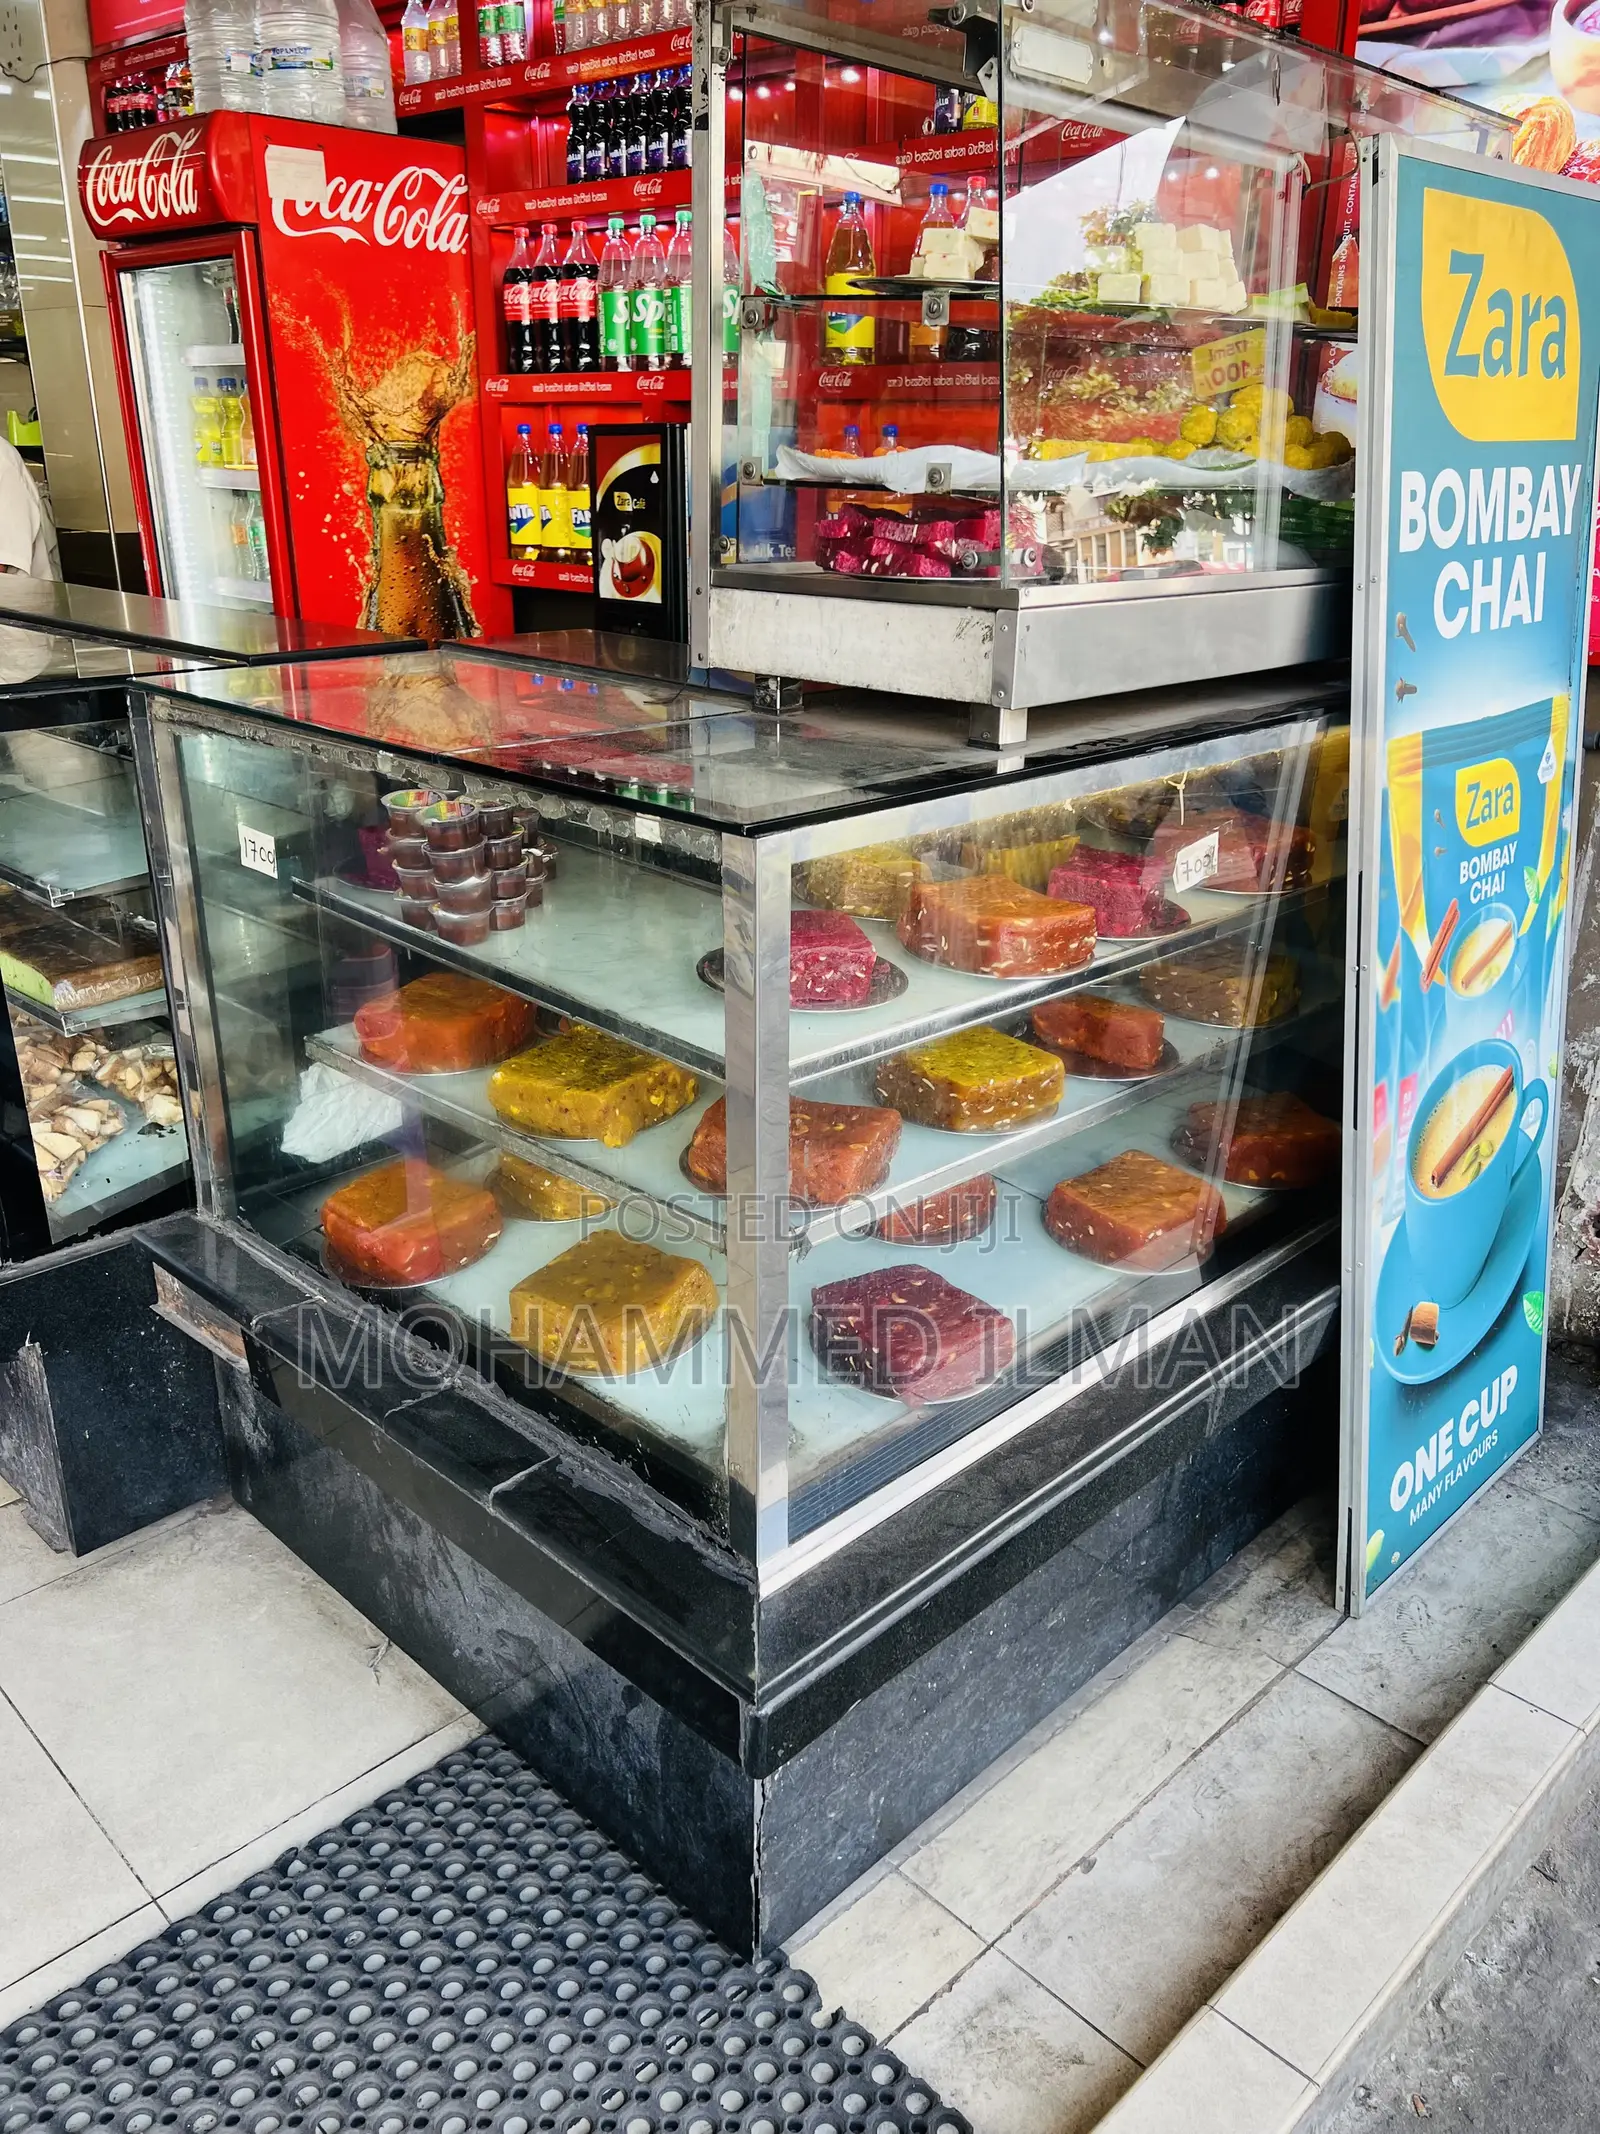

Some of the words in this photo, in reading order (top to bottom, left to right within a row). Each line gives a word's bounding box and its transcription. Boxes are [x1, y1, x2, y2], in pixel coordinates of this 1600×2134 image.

[1061, 121, 1105, 141] Coca-Cola
[86, 128, 205, 227] Coca-Cola
[634, 178, 663, 196] Coca-Cola
[1346, 172, 1358, 214] CONTAIN
[1443, 248, 1567, 380] Zara
[636, 375, 666, 390] Coca-Cola
[616, 495, 631, 506] Zara
[1399, 464, 1583, 554] BOMBAY
[1433, 551, 1547, 640] CHAI
[1465, 780, 1514, 830] Zara
[1459, 840, 1518, 885] BOMBAY
[1469, 877, 1506, 905] CHAI
[1389, 1418, 1454, 1512] ONE
[1458, 1364, 1518, 1448] CUP
[1409, 1480, 1443, 1527] MANY
[1444, 1429, 1499, 1492] FLAVOURS
